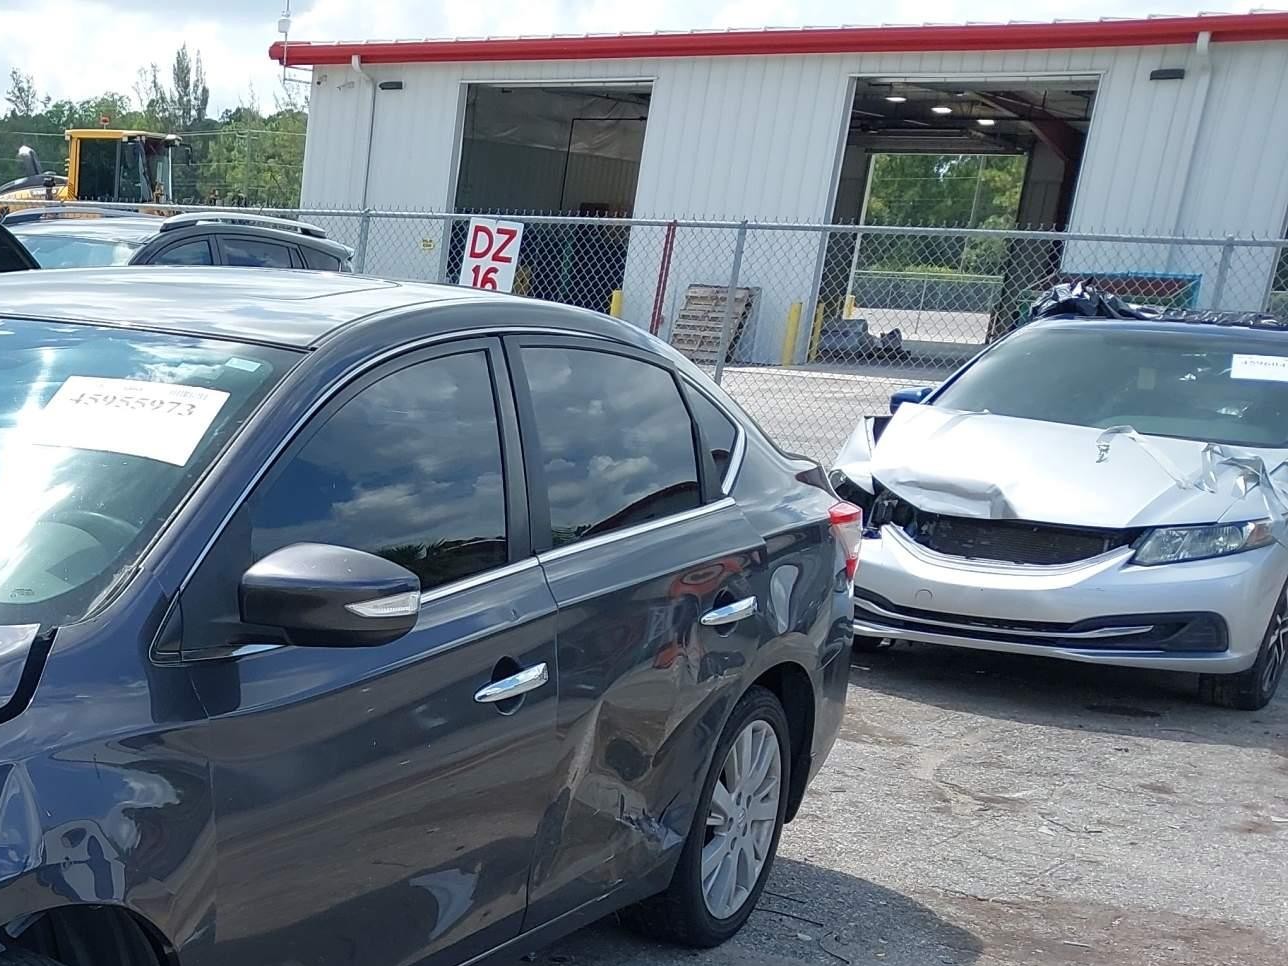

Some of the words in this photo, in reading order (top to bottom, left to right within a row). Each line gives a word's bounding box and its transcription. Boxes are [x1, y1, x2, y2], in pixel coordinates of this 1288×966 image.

[469, 224, 518, 264] DZ
[471, 264, 499, 290] 16
[68, 392, 197, 417] 45955973
